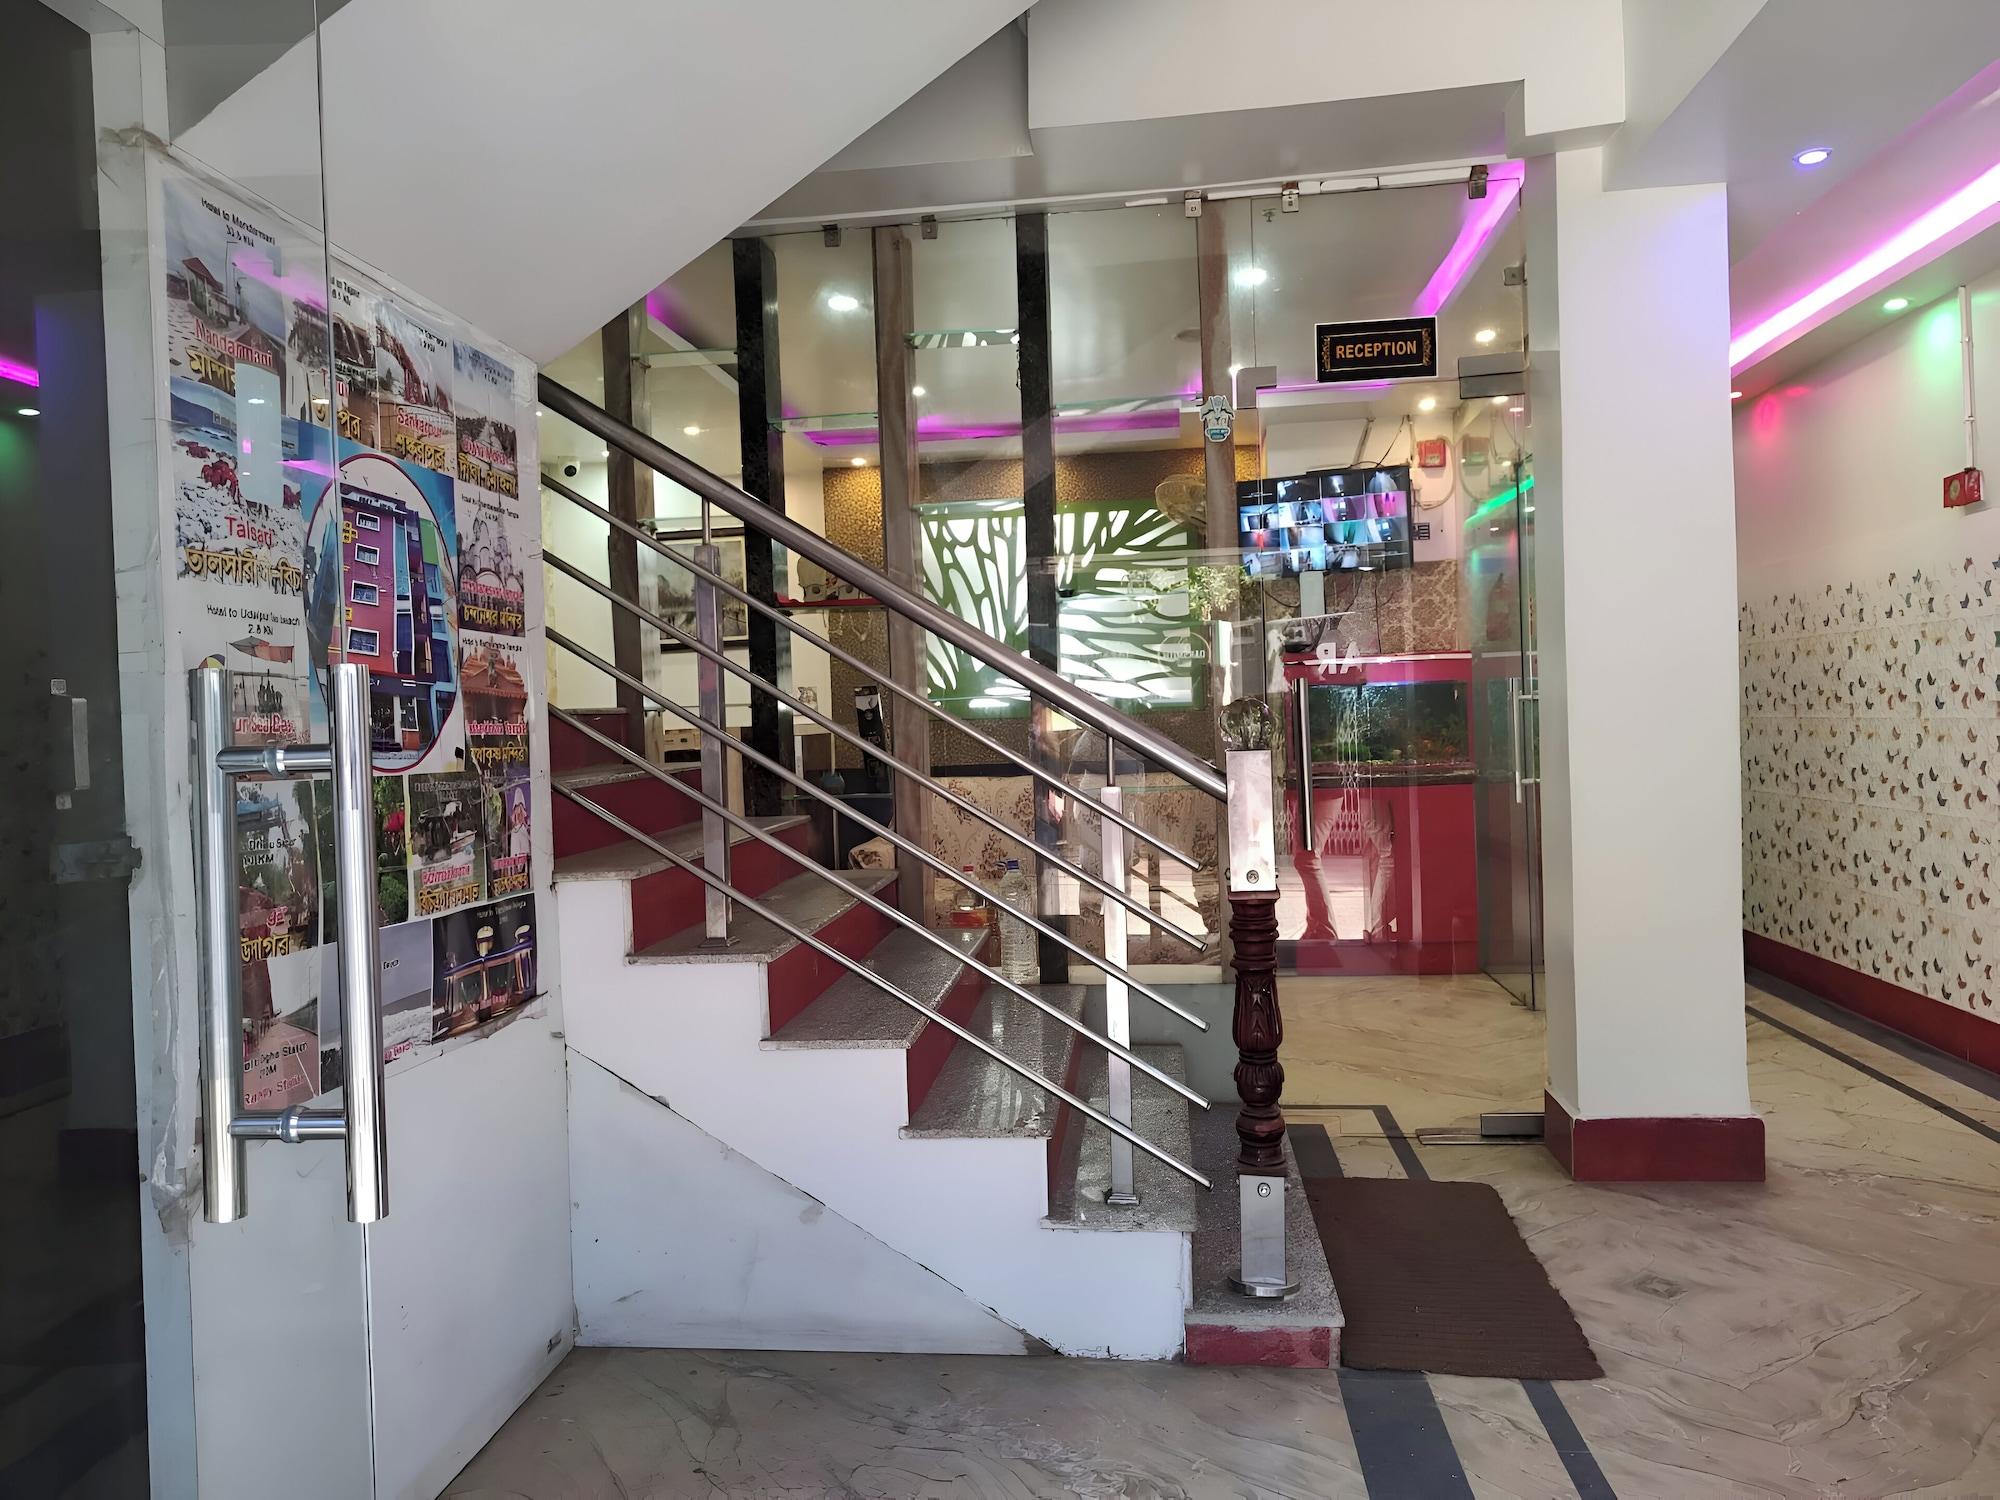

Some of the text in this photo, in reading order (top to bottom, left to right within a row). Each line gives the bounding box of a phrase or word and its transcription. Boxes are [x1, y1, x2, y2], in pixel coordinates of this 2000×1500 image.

[1335, 340, 1417, 359] RECEPTION
[224, 516, 273, 546] Talsari
[207, 604, 227, 617] Hotel
[228, 607, 238, 618] to
